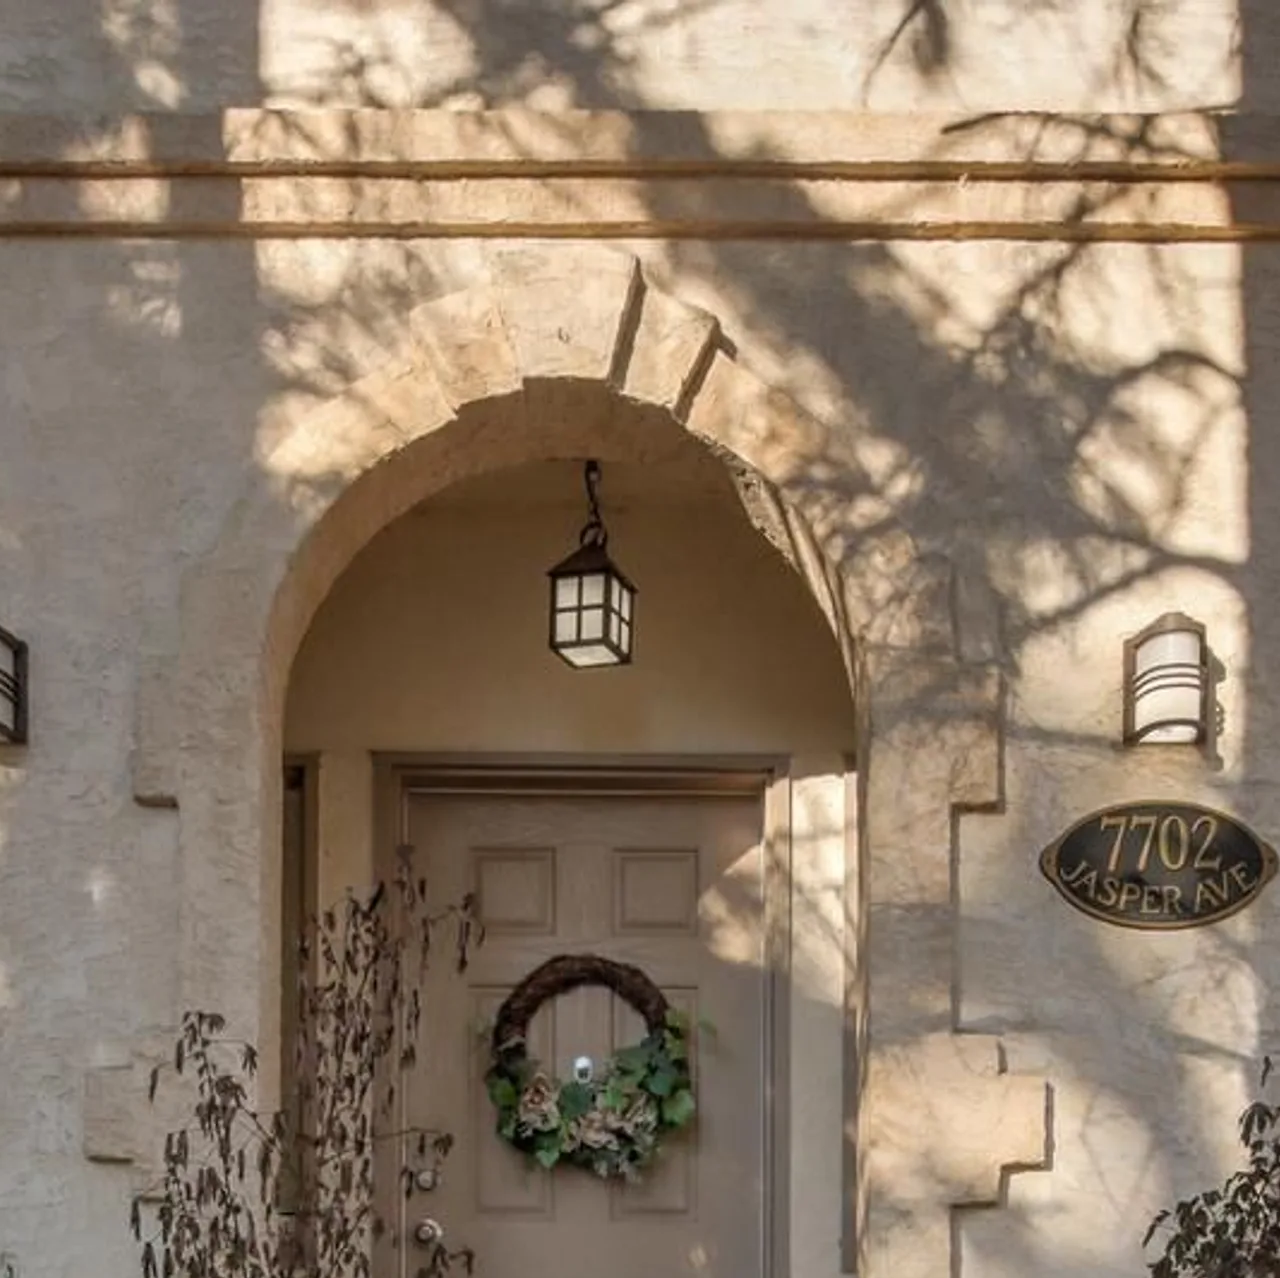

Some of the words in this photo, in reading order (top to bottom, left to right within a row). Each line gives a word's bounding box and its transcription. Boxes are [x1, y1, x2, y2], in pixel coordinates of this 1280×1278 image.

[1100, 815, 1222, 872] 7702
[1060, 860, 1183, 914] JASPER
[1193, 861, 1258, 913] AVE
